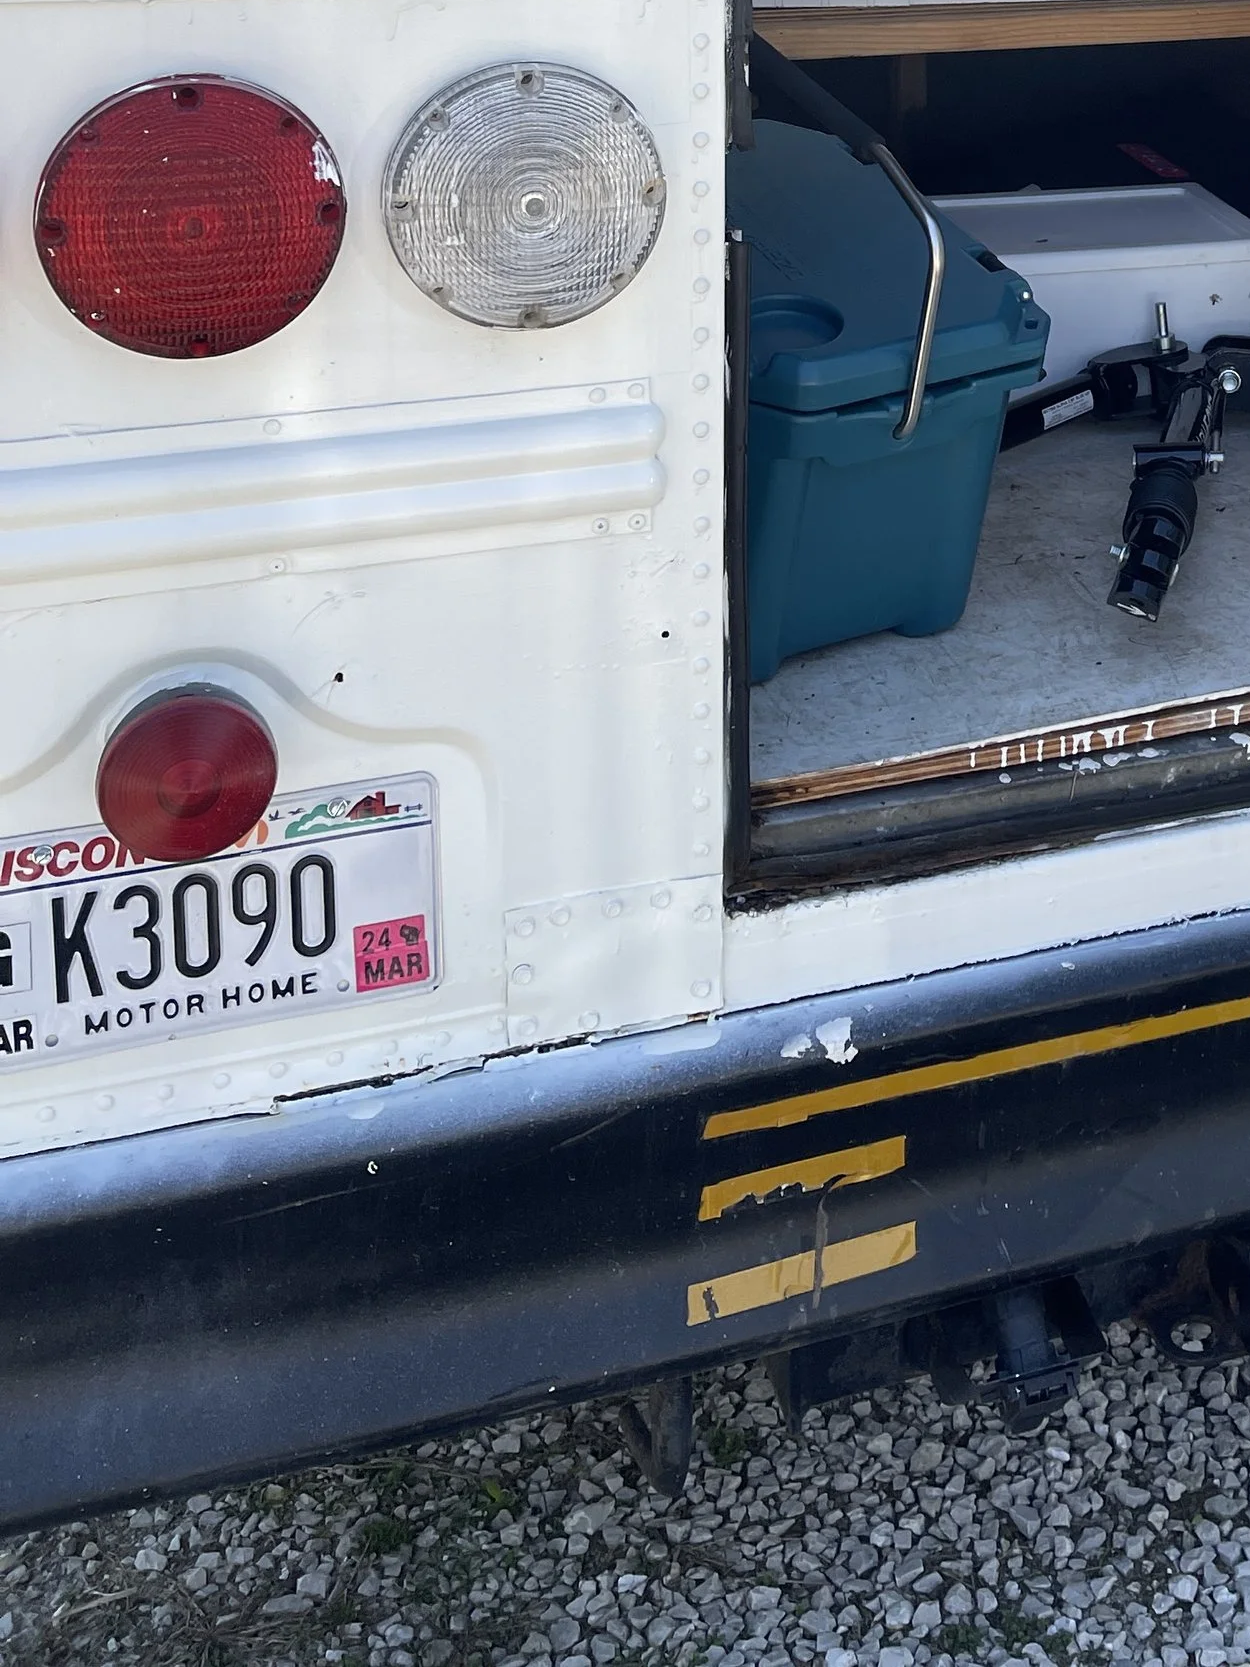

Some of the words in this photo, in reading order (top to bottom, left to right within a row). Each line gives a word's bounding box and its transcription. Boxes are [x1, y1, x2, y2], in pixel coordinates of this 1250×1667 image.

[0, 835, 146, 886] ISCON
[51, 853, 337, 1005] K3090
[362, 926, 392, 955] 24
[364, 952, 423, 985] MAR
[84, 993, 205, 1035] MOTOR
[221, 971, 319, 1009] HOME
